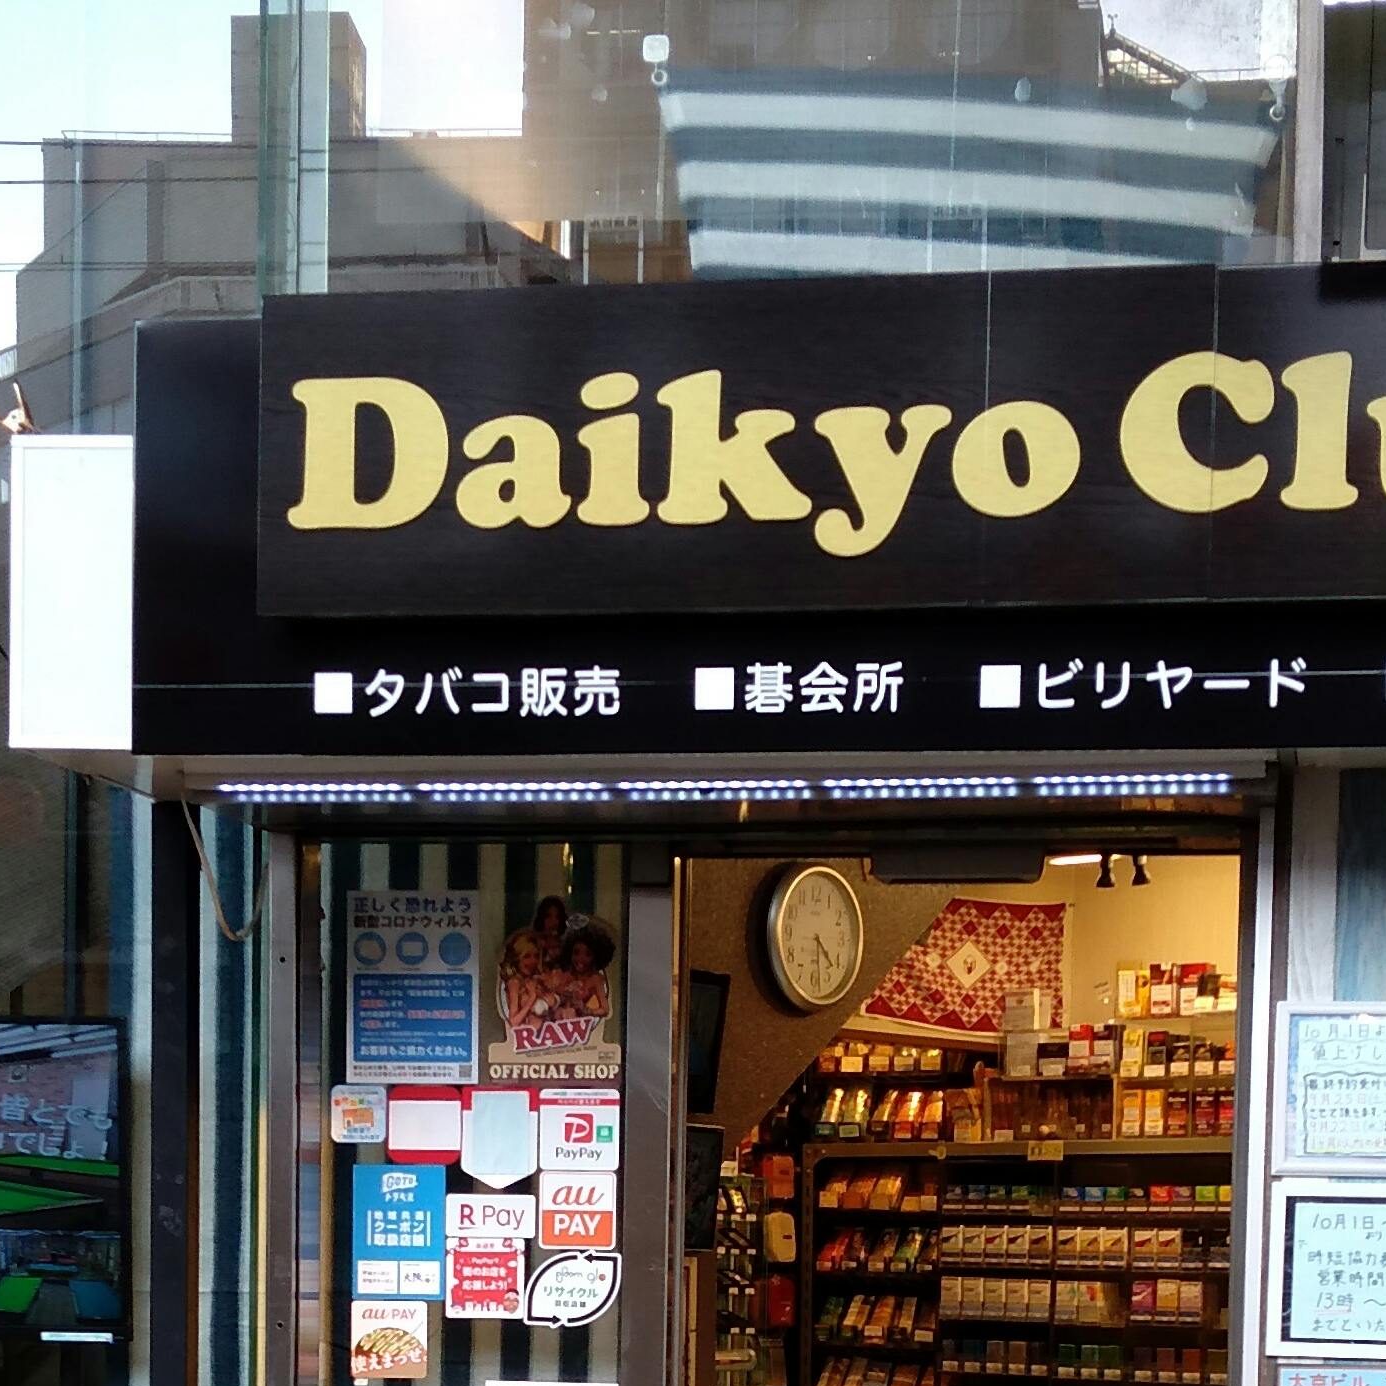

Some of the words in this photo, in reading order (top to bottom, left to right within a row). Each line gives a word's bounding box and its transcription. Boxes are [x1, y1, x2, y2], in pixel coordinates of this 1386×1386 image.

[287, 369, 1082, 557] Daikyo
[363, 665, 621, 717] タバコ販売
[744, 660, 904, 714] 碁会所
[1036, 655, 1308, 711] ビリヤード
[513, 1017, 595, 1053] RAW
[489, 1065, 570, 1081] OFFICIAL
[573, 1065, 620, 1081] SHOP
[555, 1146, 603, 1161] PayPay
[551, 1184, 605, 1207] au
[374, 1222, 425, 1234] クーポン
[459, 1204, 477, 1230] R
[482, 1206, 526, 1230] Pay
[553, 1214, 602, 1237] PAY
[543, 1286, 599, 1299] リサイクル
[361, 1307, 390, 1320] au
[391, 1308, 417, 1321] PAY
